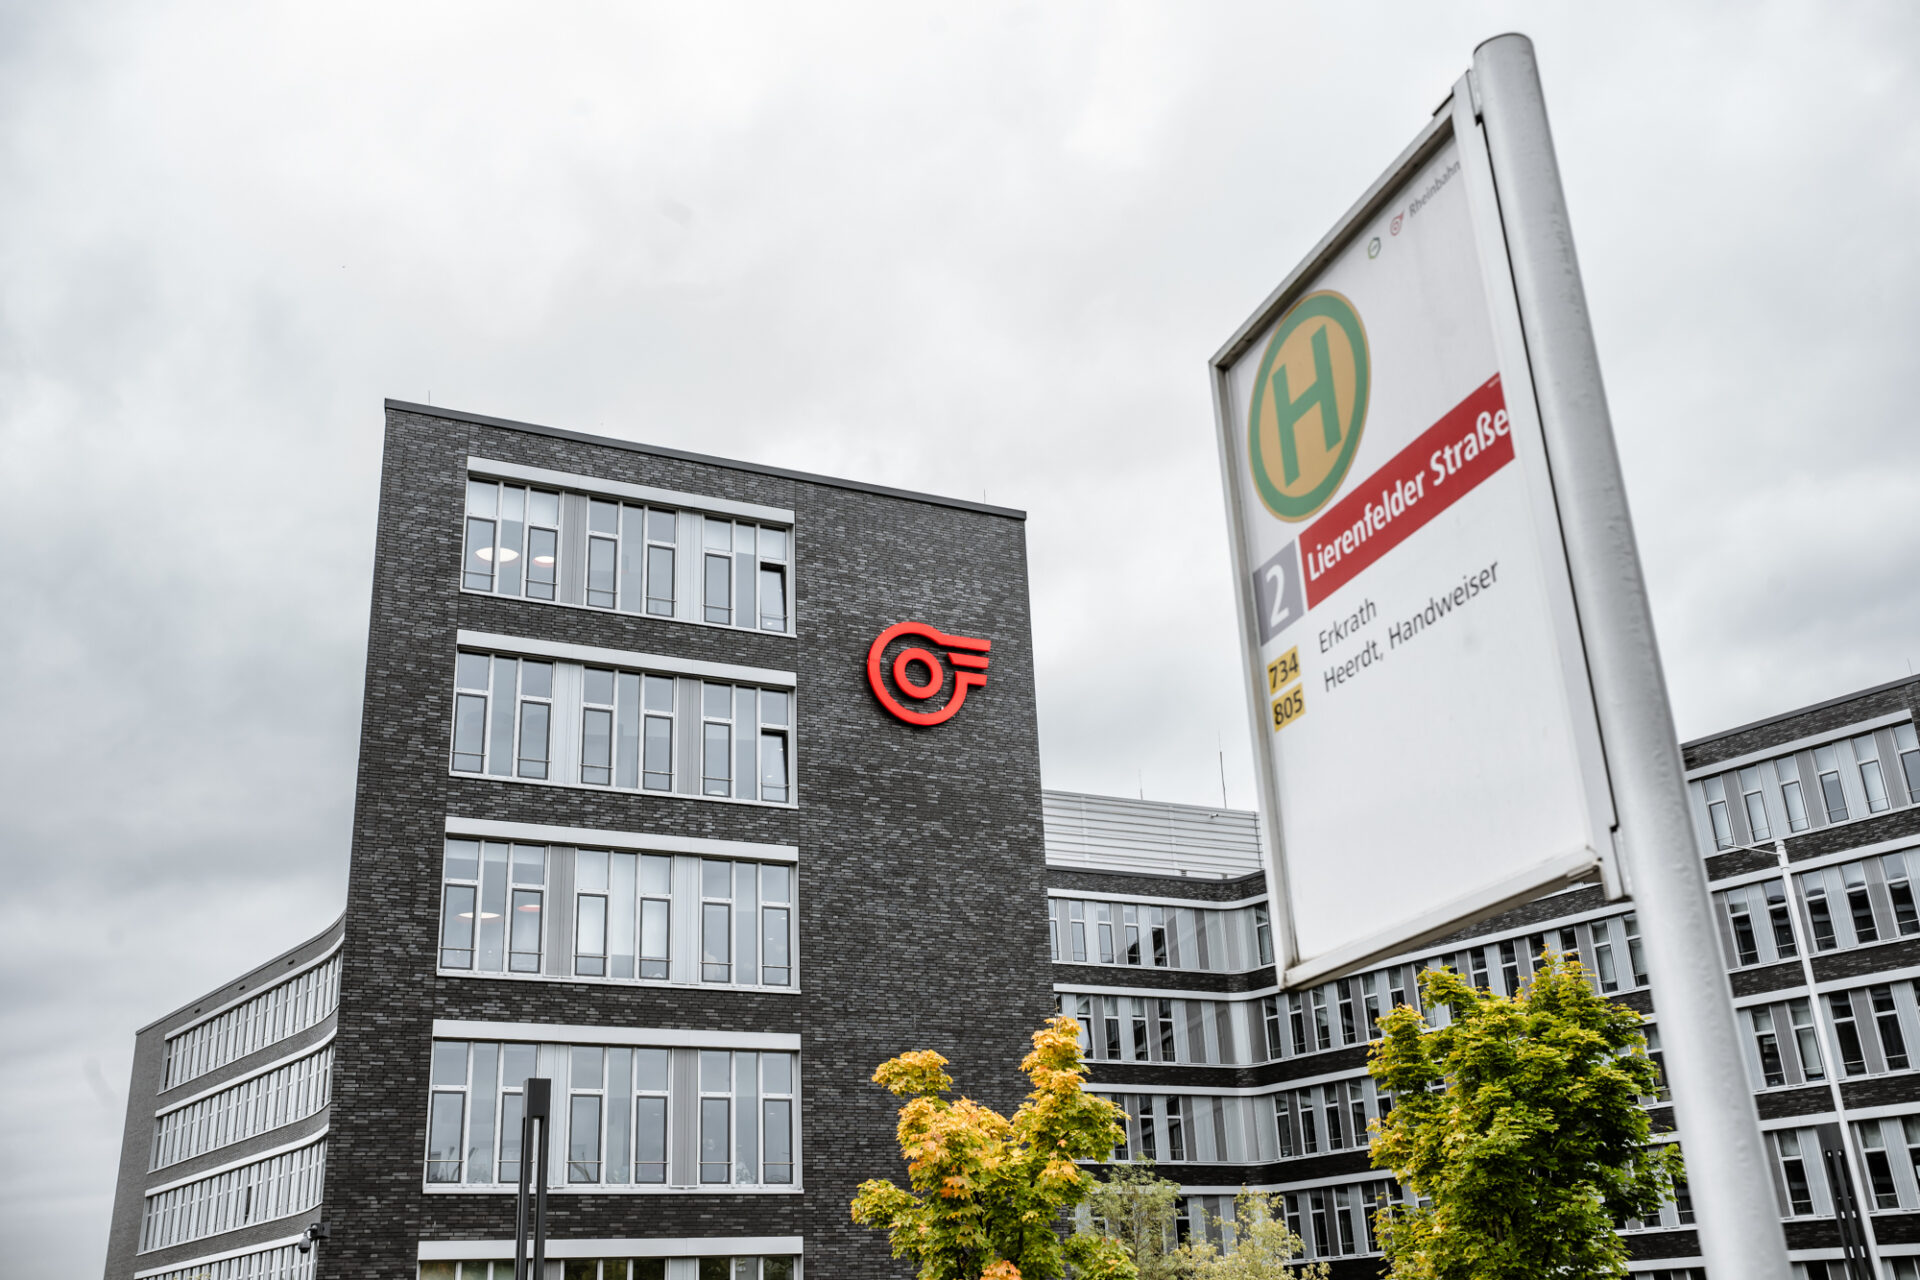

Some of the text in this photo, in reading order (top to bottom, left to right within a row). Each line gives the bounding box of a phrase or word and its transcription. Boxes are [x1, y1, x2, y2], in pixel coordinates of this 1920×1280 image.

[1408, 160, 1461, 218] Rheinbahn
[1271, 322, 1342, 489] H
[1307, 408, 1510, 581] Lierenfelder Straße
[1265, 564, 1290, 629] 2
[1318, 597, 1377, 654] Erkrath
[1323, 561, 1499, 693] Heerdt, Handweiser
[1268, 652, 1299, 689] 734
[1274, 690, 1303, 726] 805
